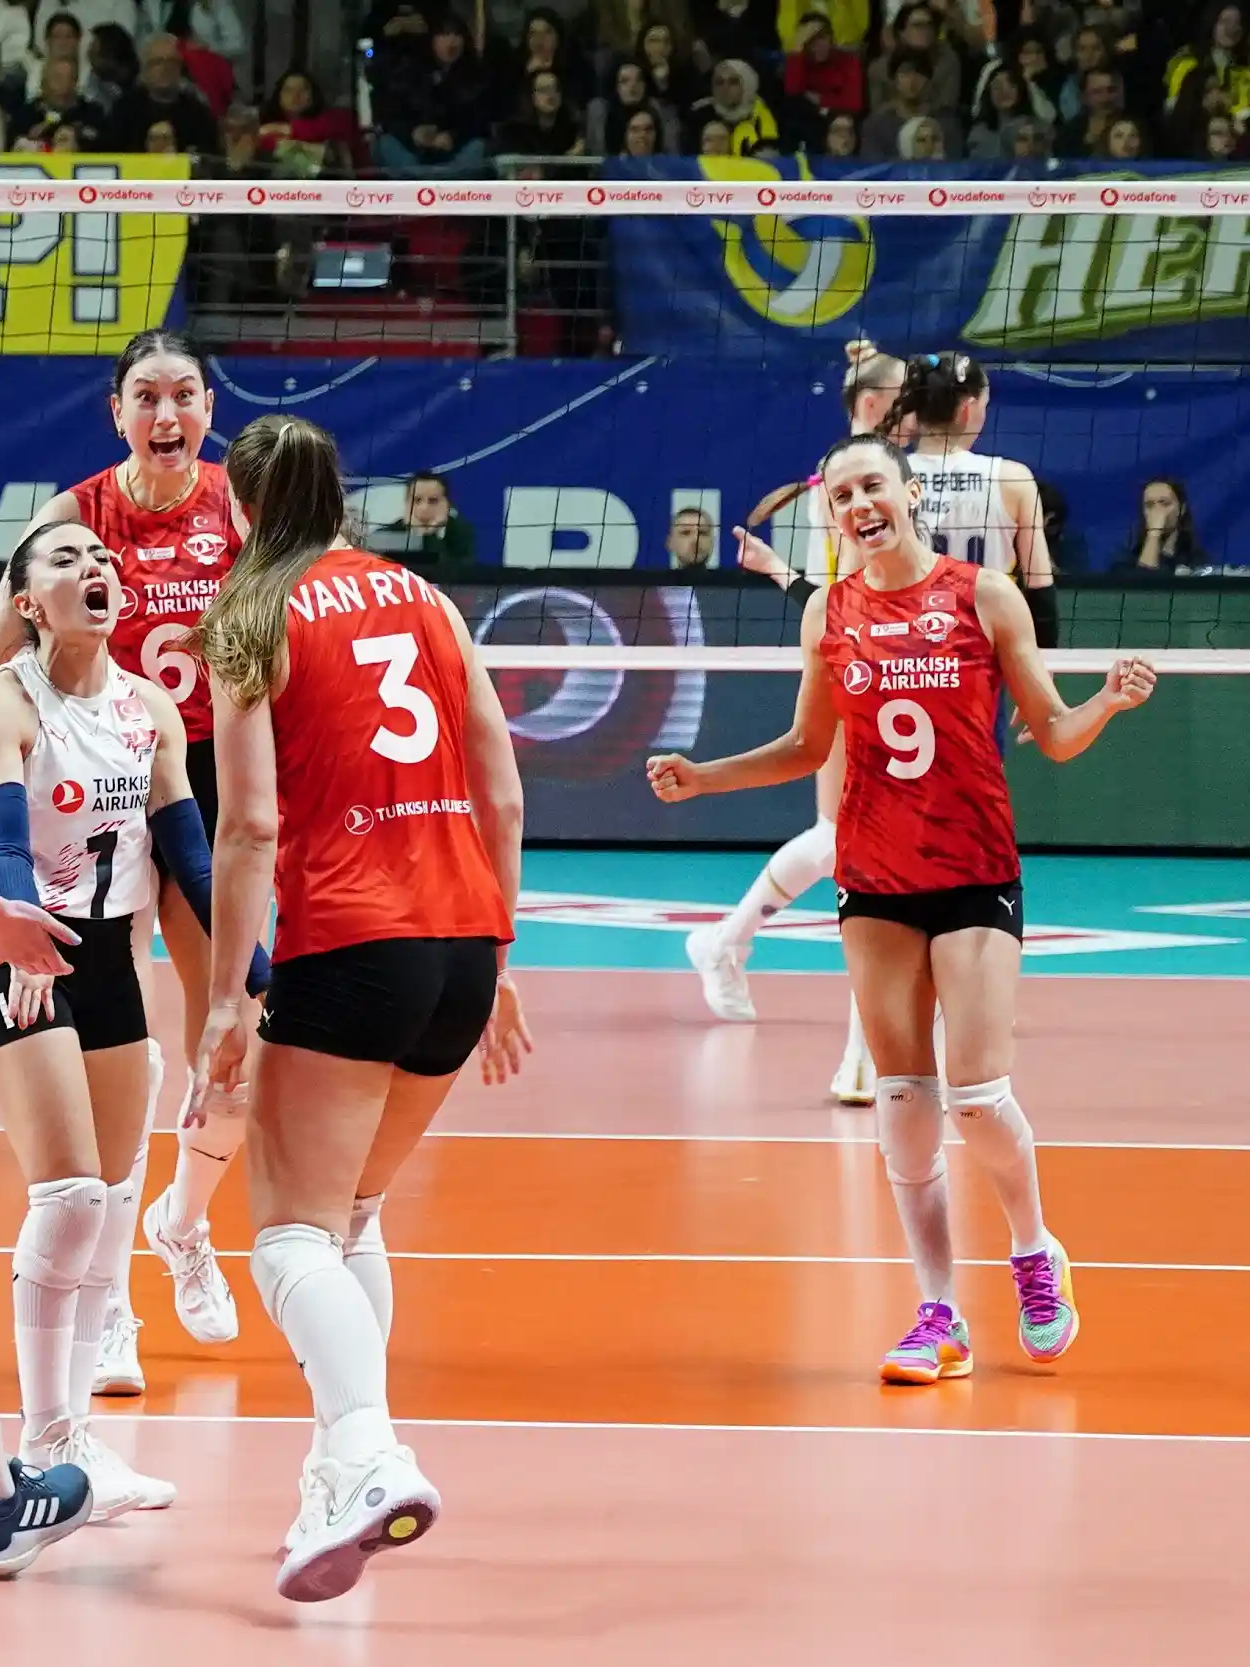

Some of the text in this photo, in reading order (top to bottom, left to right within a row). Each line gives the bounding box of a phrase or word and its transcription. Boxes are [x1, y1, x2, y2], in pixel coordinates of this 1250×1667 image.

[29, 191, 55, 203] TVF
[100, 189, 155, 201] vodafone
[197, 191, 224, 205] TVF
[269, 189, 323, 202] vodafone
[367, 192, 395, 205] TVF
[435, 190, 493, 202] vodafone
[537, 192, 564, 204] TVF
[608, 189, 664, 203] vodafone
[707, 191, 735, 205] TVF
[779, 190, 834, 203] vodafone
[877, 193, 906, 205] TVF
[950, 190, 1006, 203] vodafone
[1049, 192, 1077, 205] TVF
[1122, 191, 1178, 203] vodafone
[1221, 193, 1250, 205] TVF
[144, 580, 220, 599] TURKISH
[289, 576, 366, 622] VAN
[141, 623, 199, 704] 6
[879, 657, 959, 675] TURKISH
[879, 672, 960, 690] AIRLINES
[352, 632, 439, 764] 3
[877, 699, 936, 779] 9
[93, 775, 149, 795] TURKIS
[86, 830, 118, 919] 1
